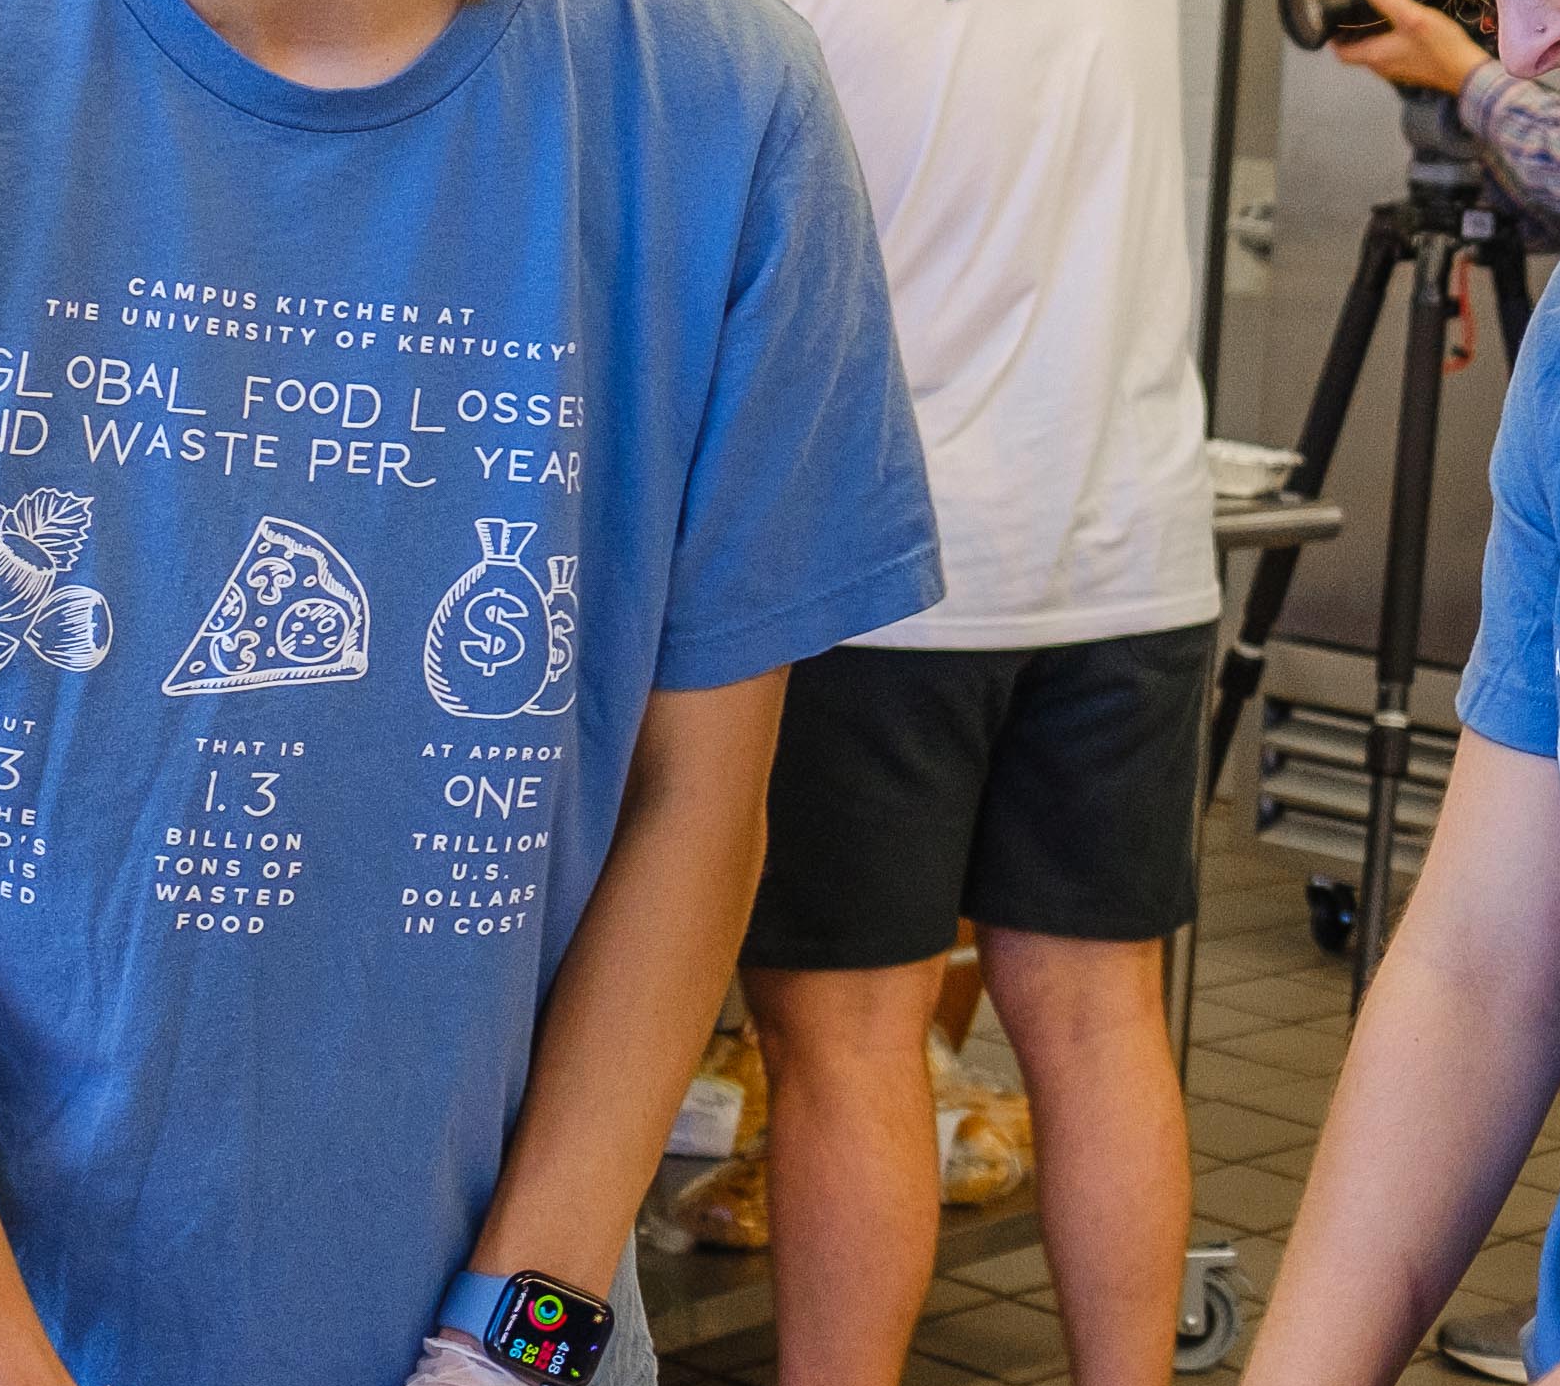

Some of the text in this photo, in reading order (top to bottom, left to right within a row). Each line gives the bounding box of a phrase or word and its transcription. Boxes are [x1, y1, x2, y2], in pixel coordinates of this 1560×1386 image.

[127, 277, 477, 327] CAMPUS KITCHEN AT
[45, 298, 100, 322] THE
[121, 307, 318, 349] UNIVERSITY
[336, 330, 377, 351] OF
[242, 374, 381, 431] FOOD
[83, 418, 279, 475] WASTE
[309, 438, 437, 489] PER
[474, 445, 581, 494] YEAR
[196, 737, 306, 758] THAT IS
[422, 744, 563, 762] AT APPROX
[444, 773, 540, 820] ONE
[165, 827, 303, 852] BILLION
[413, 831, 549, 853] TRILLION
[8, 859, 36, 879] IS
[155, 856, 303, 880] TONS OF
[451, 861, 510, 882] U.S.
[155, 883, 297, 908] WASTED
[402, 886, 536, 910] DOLLARS
[175, 912, 265, 935] FOOD
[404, 911, 526, 937] IN COST
[522, 1343, 539, 1364] 33
[548, 1341, 570, 1375] 4:08
